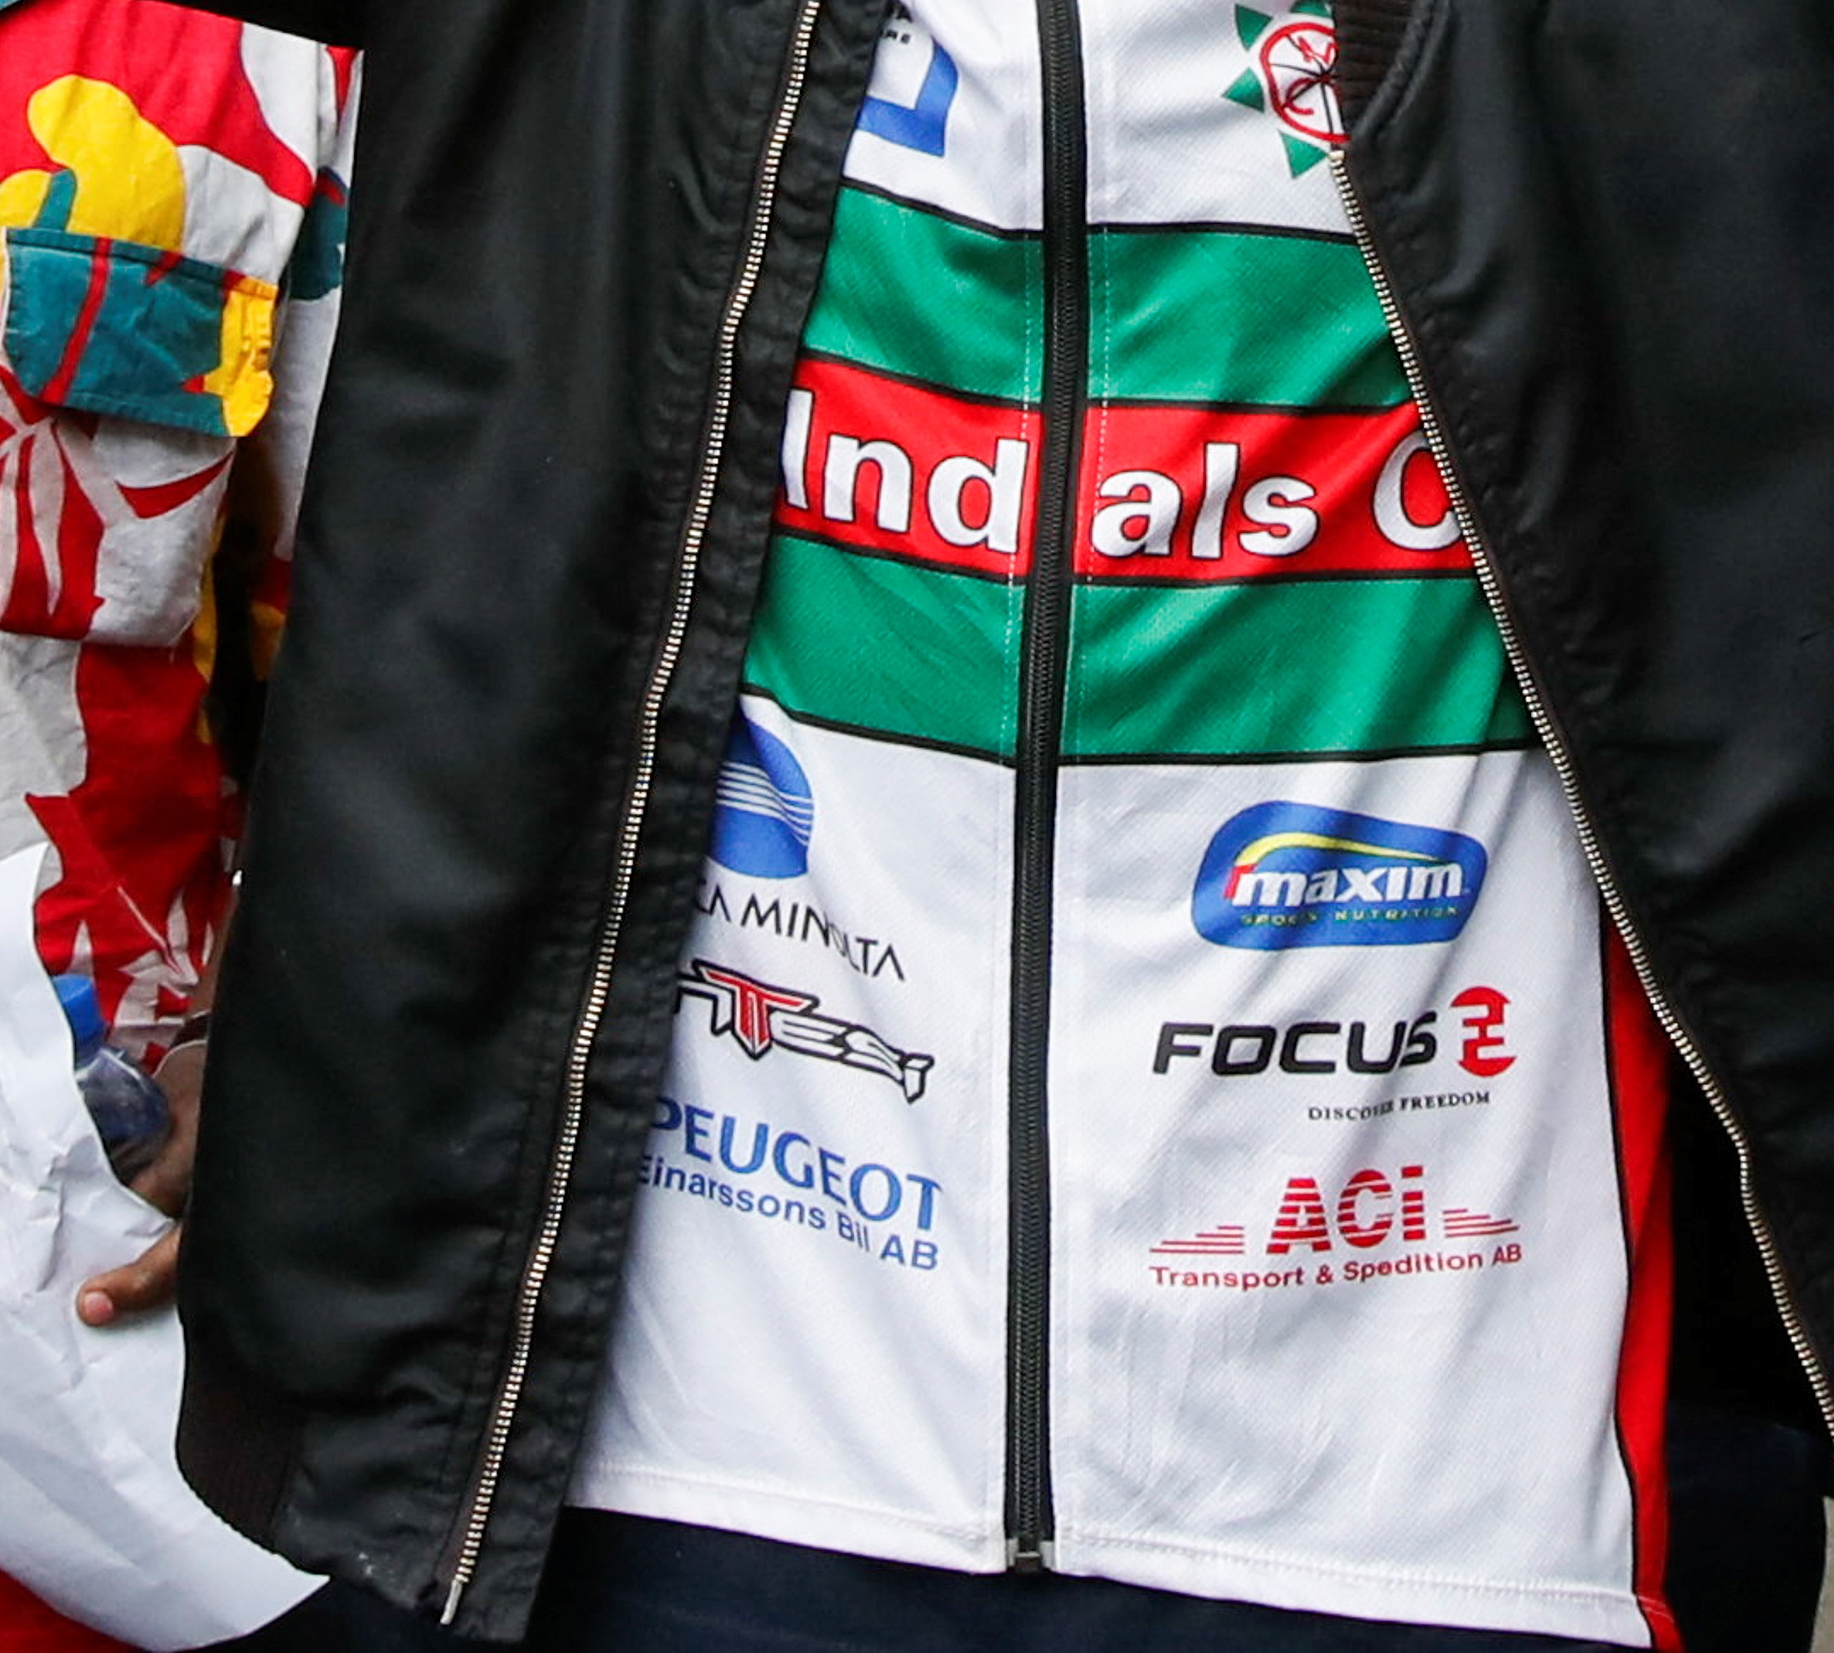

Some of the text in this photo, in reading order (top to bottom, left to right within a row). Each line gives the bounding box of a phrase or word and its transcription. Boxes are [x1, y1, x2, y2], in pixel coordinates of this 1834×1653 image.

[1223, 861, 1463, 907] maxim
[1152, 1010, 1438, 1077] FOCUS
[1399, 1090, 1491, 1112] FREEDOM
[654, 1095, 943, 1232] PEUGEOT
[879, 1233, 940, 1272] AB
[1149, 1243, 1523, 1293] Transport & Spedition AB
